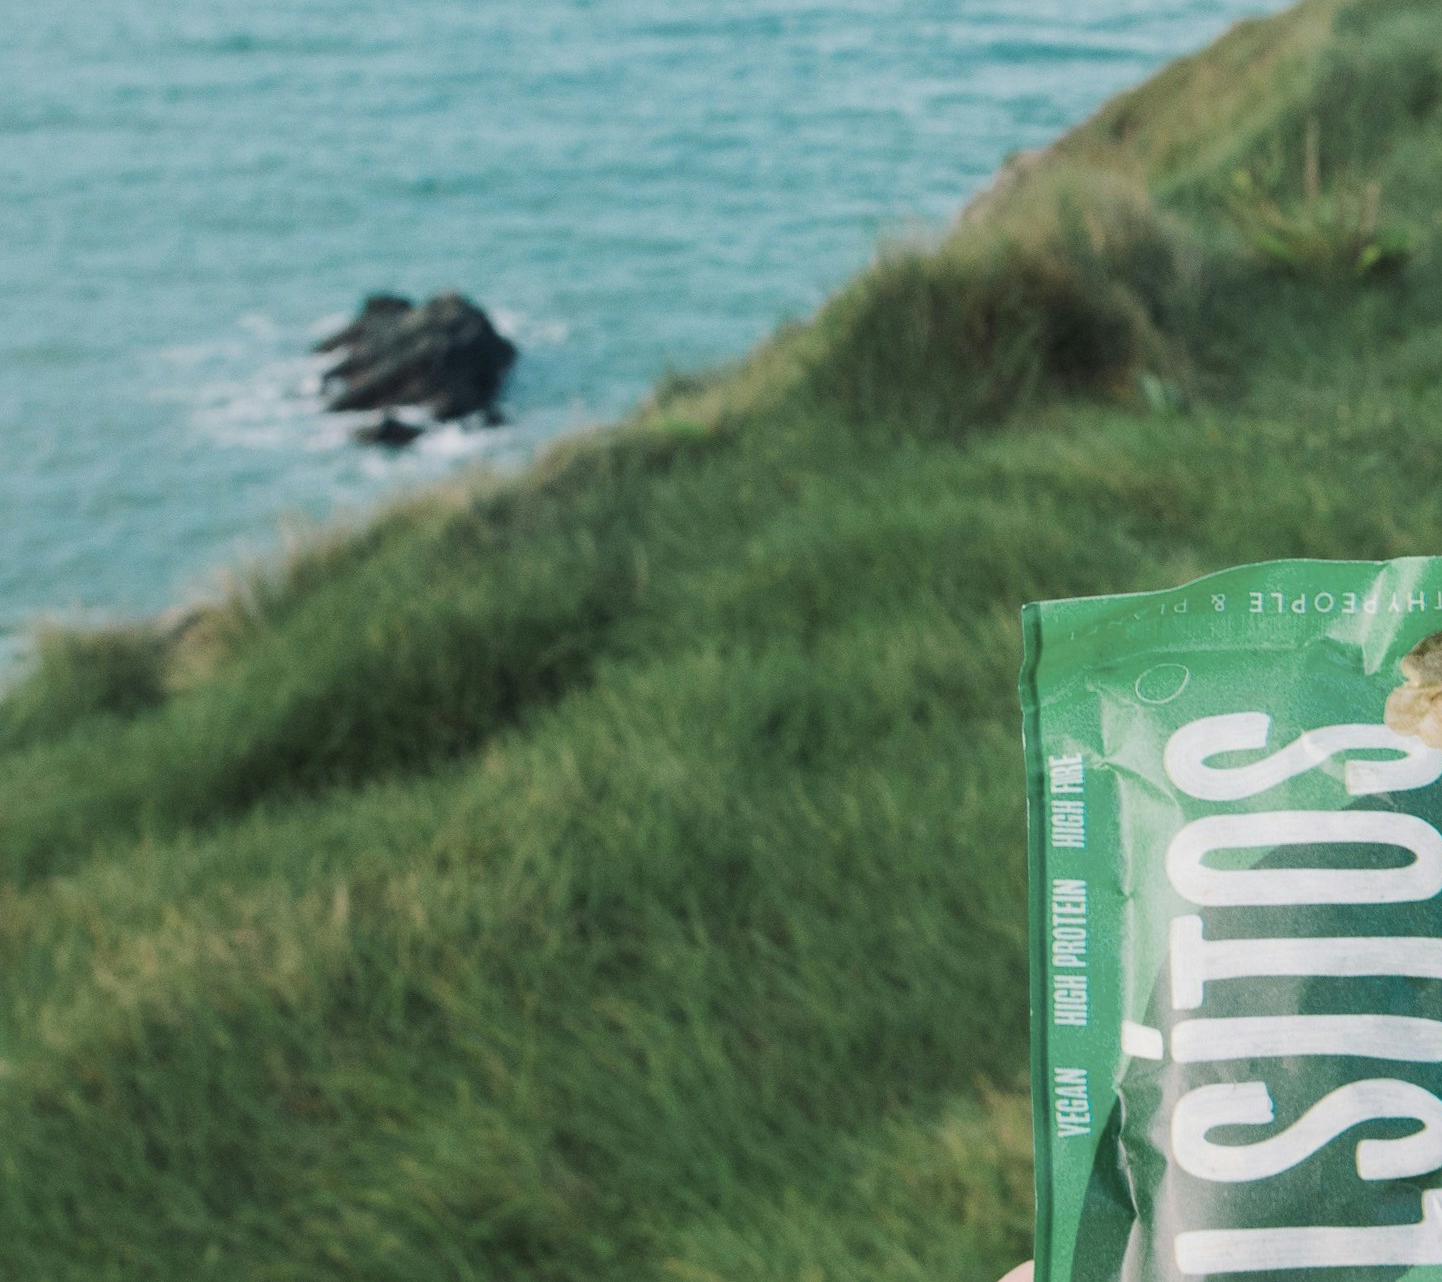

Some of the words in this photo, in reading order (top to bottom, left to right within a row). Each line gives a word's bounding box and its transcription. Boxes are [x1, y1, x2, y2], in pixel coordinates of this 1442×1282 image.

[1051, 799, 1086, 848] HIGH
[1052, 878, 1088, 969] PROTEIN
[1053, 974, 1088, 1027] HIGH
[1054, 1067, 1091, 1138] VEGAN
